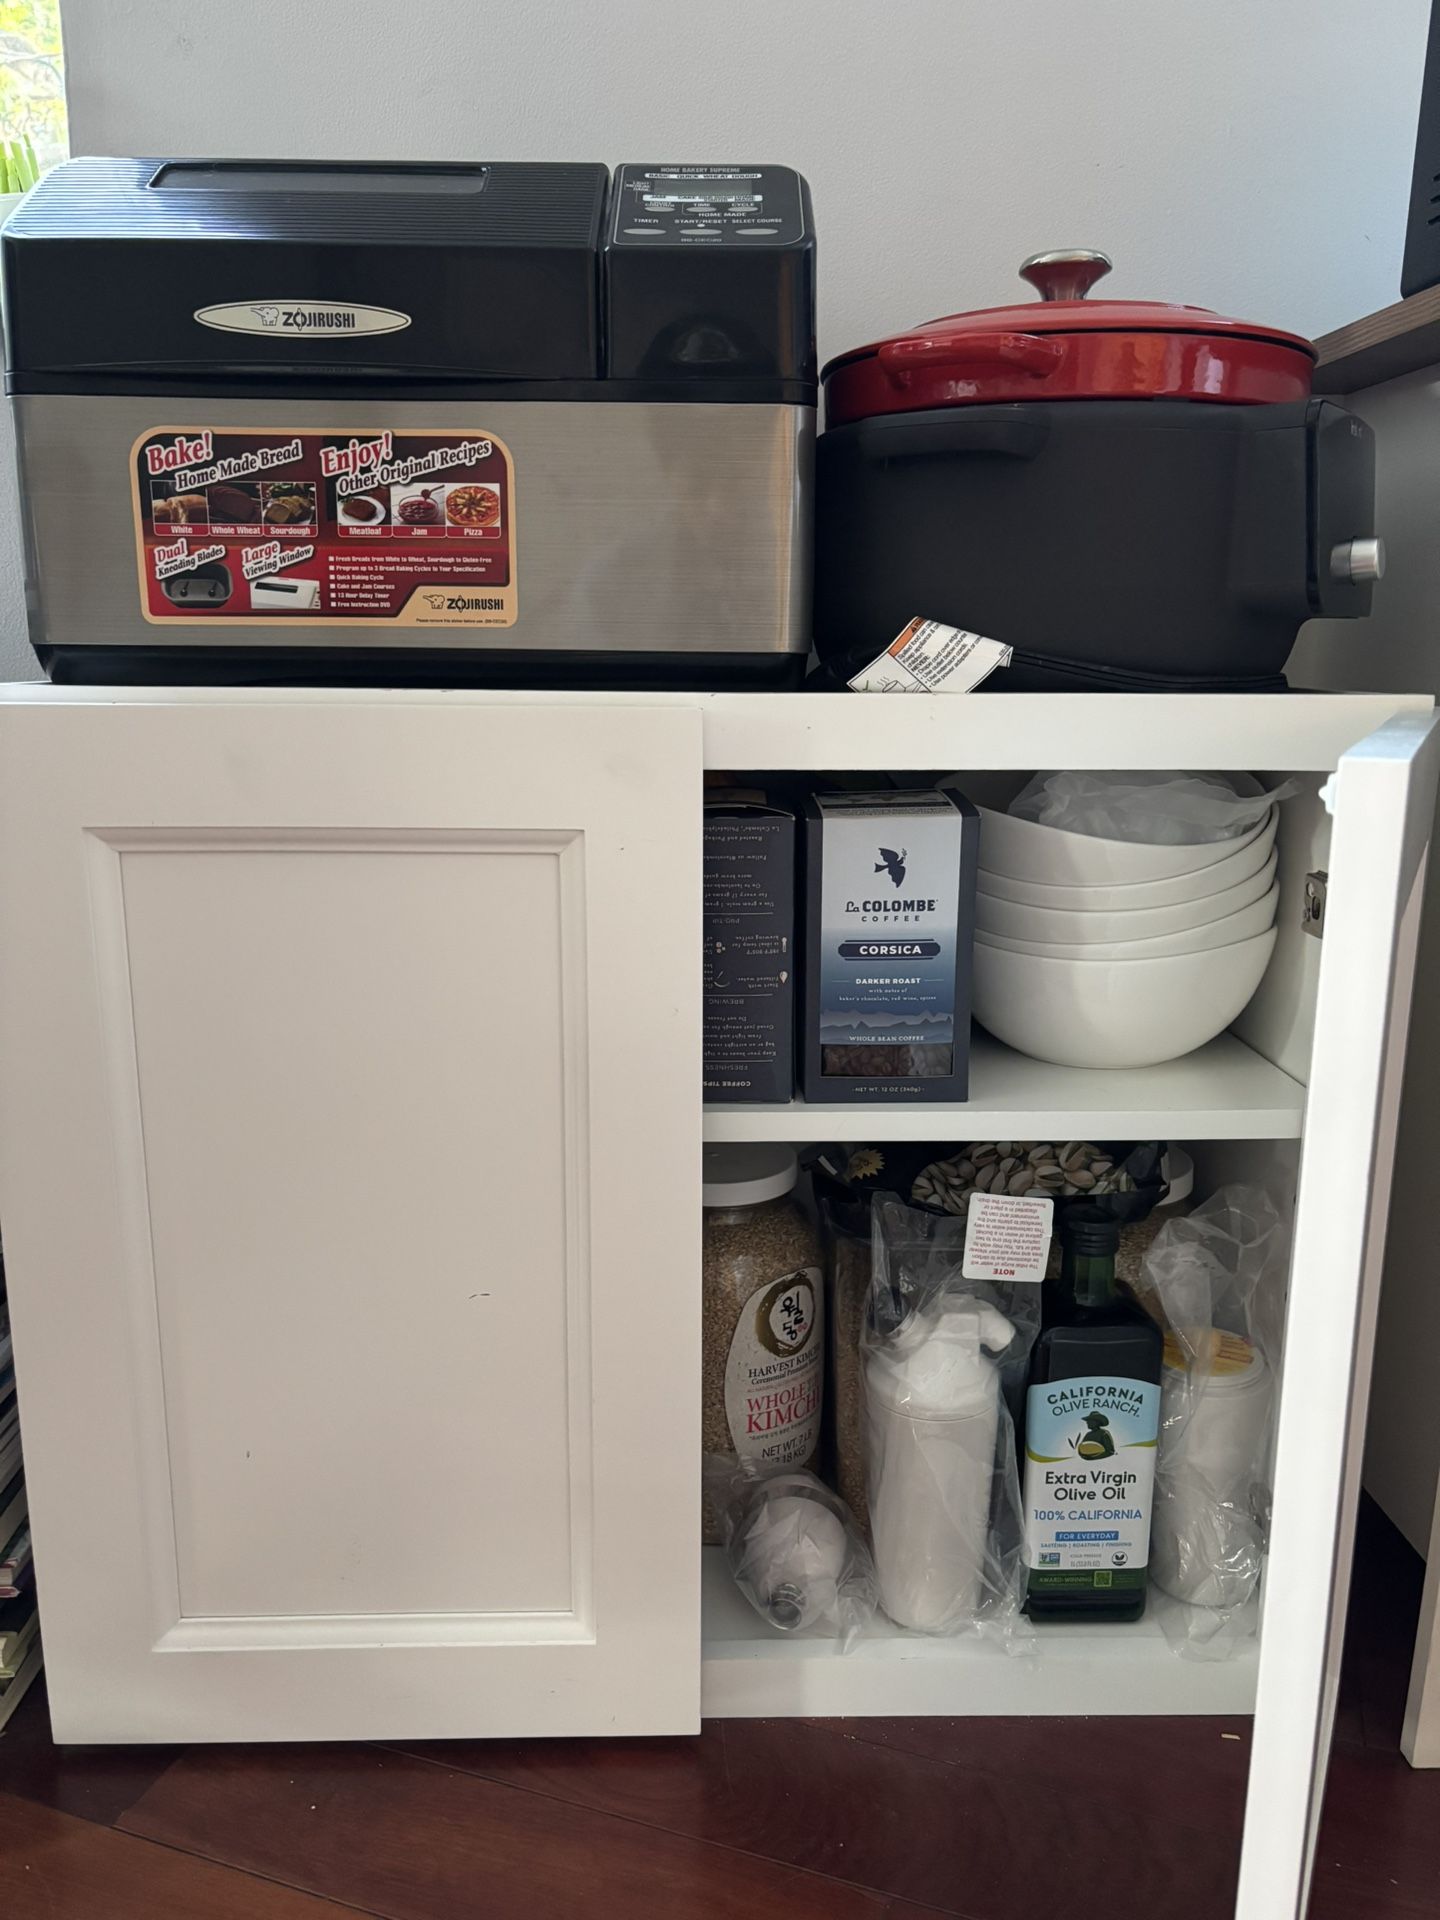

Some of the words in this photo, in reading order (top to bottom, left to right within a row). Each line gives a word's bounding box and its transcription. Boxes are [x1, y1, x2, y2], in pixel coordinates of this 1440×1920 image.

[282, 308, 355, 331] ZOJIRUSHI
[148, 433, 212, 472] Bake!
[321, 433, 392, 474] Enjoy!
[177, 468, 217, 489] Home
[220, 457, 257, 478] Made
[259, 443, 301, 467] Bread
[339, 474, 377, 493] Other
[380, 453, 436, 480] Original
[440, 442, 490, 465] Recipes
[171, 525, 193, 534] White
[212, 526, 235, 534] Whole
[237, 526, 261, 535] Wheat
[270, 526, 311, 536] Sourdough
[349, 527, 382, 535] Meatloaf
[411, 528, 428, 536] Jam
[464, 528, 483, 536] Pizza
[156, 541, 185, 562] Dual
[244, 542, 279, 564] Large
[158, 556, 195, 577] Kneading
[197, 546, 224, 563] Blades
[245, 557, 277, 578] Viewing
[279, 547, 312, 564] Window
[446, 594, 504, 613] ZOJIRUSHI
[844, 901, 860, 913] La
[862, 900, 936, 913] COLOMBE
[860, 946, 922, 955] CORSICA
[992, 1268, 1015, 1276] NOTE
[748, 1359, 796, 1378] HARVEST
[746, 1382, 806, 1412] WHOLE
[1047, 1386, 1144, 1405] CALIFORNIA
[1052, 1399, 1090, 1417] OLIVE
[762, 1444, 781, 1459] NET
[1045, 1471, 1087, 1485] Extra
[1090, 1470, 1137, 1487] Virgin
[1054, 1487, 1097, 1501] Olive
[1102, 1487, 1126, 1500] Oil
[1033, 1509, 1066, 1521] 100%
[1067, 1508, 1143, 1520] CALIFORNIA
[1077, 1532, 1116, 1540] EVERYDAY
